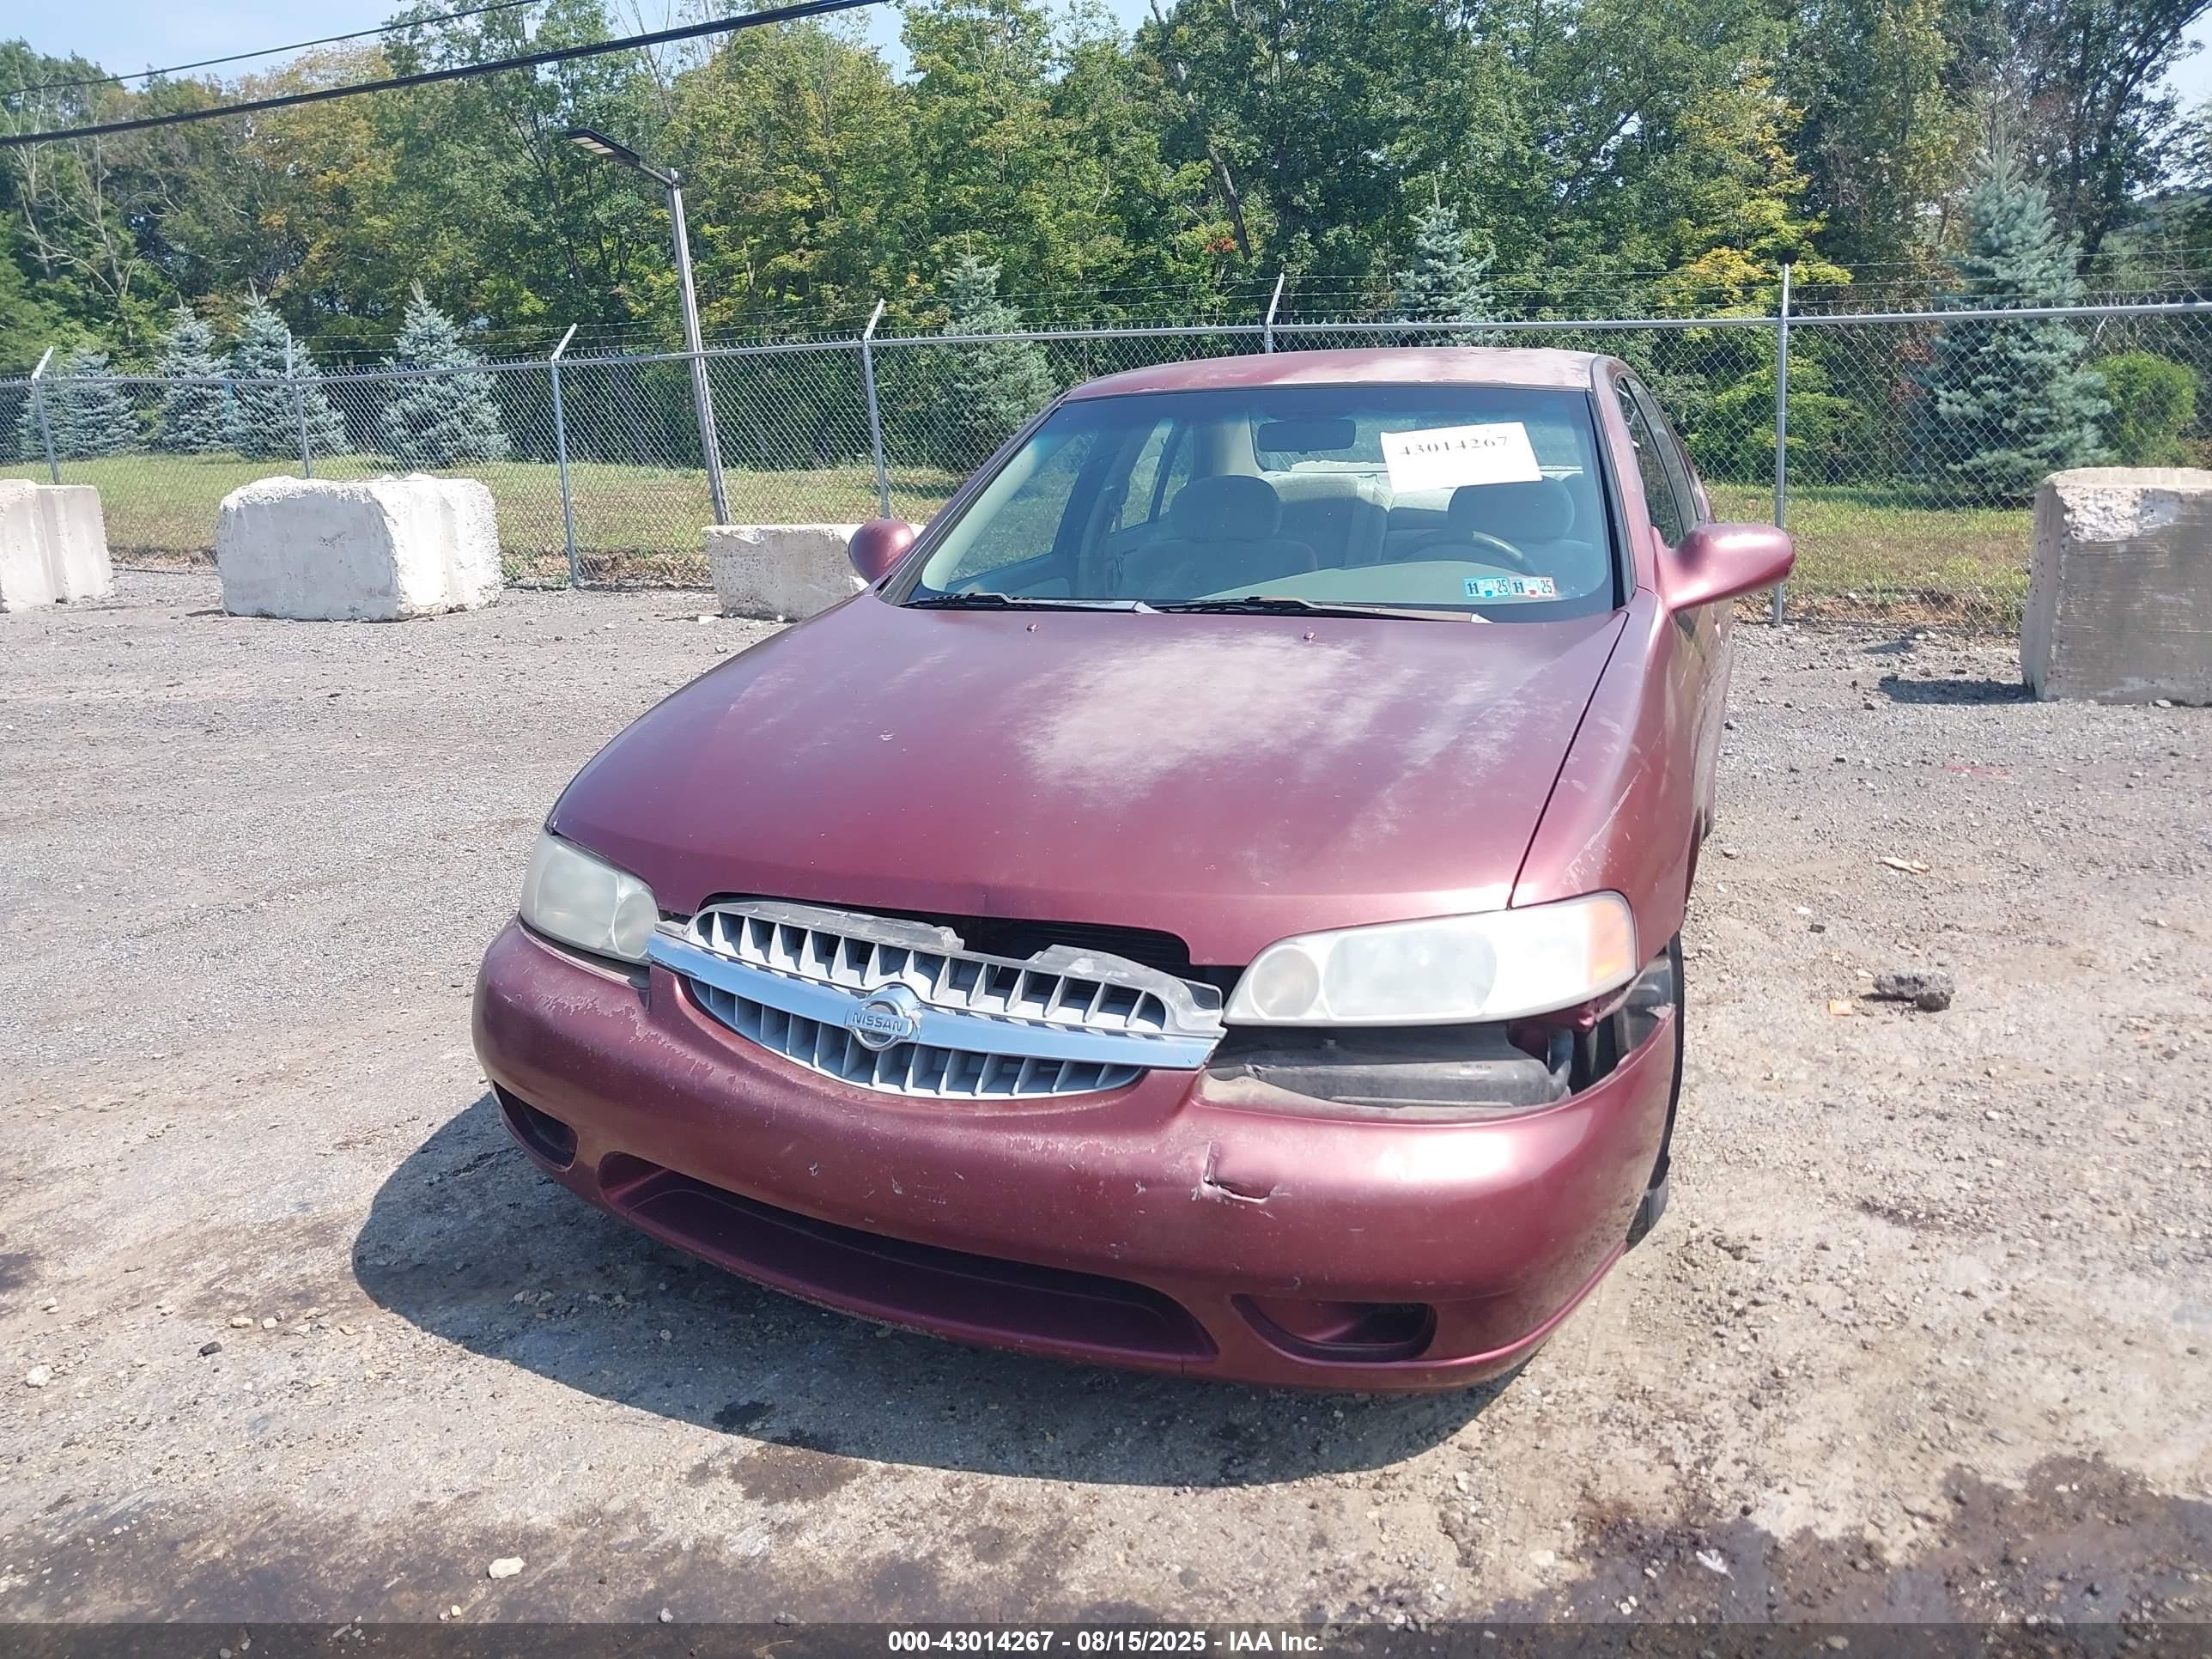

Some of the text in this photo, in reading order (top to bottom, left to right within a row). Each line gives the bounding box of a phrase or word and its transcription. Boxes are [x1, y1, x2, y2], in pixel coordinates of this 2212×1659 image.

[1400, 436, 1507, 456] 43014267
[1496, 580, 1509, 593] 25
[1540, 580, 1553, 594] 25
[852, 1012, 902, 1031] NISSAN
